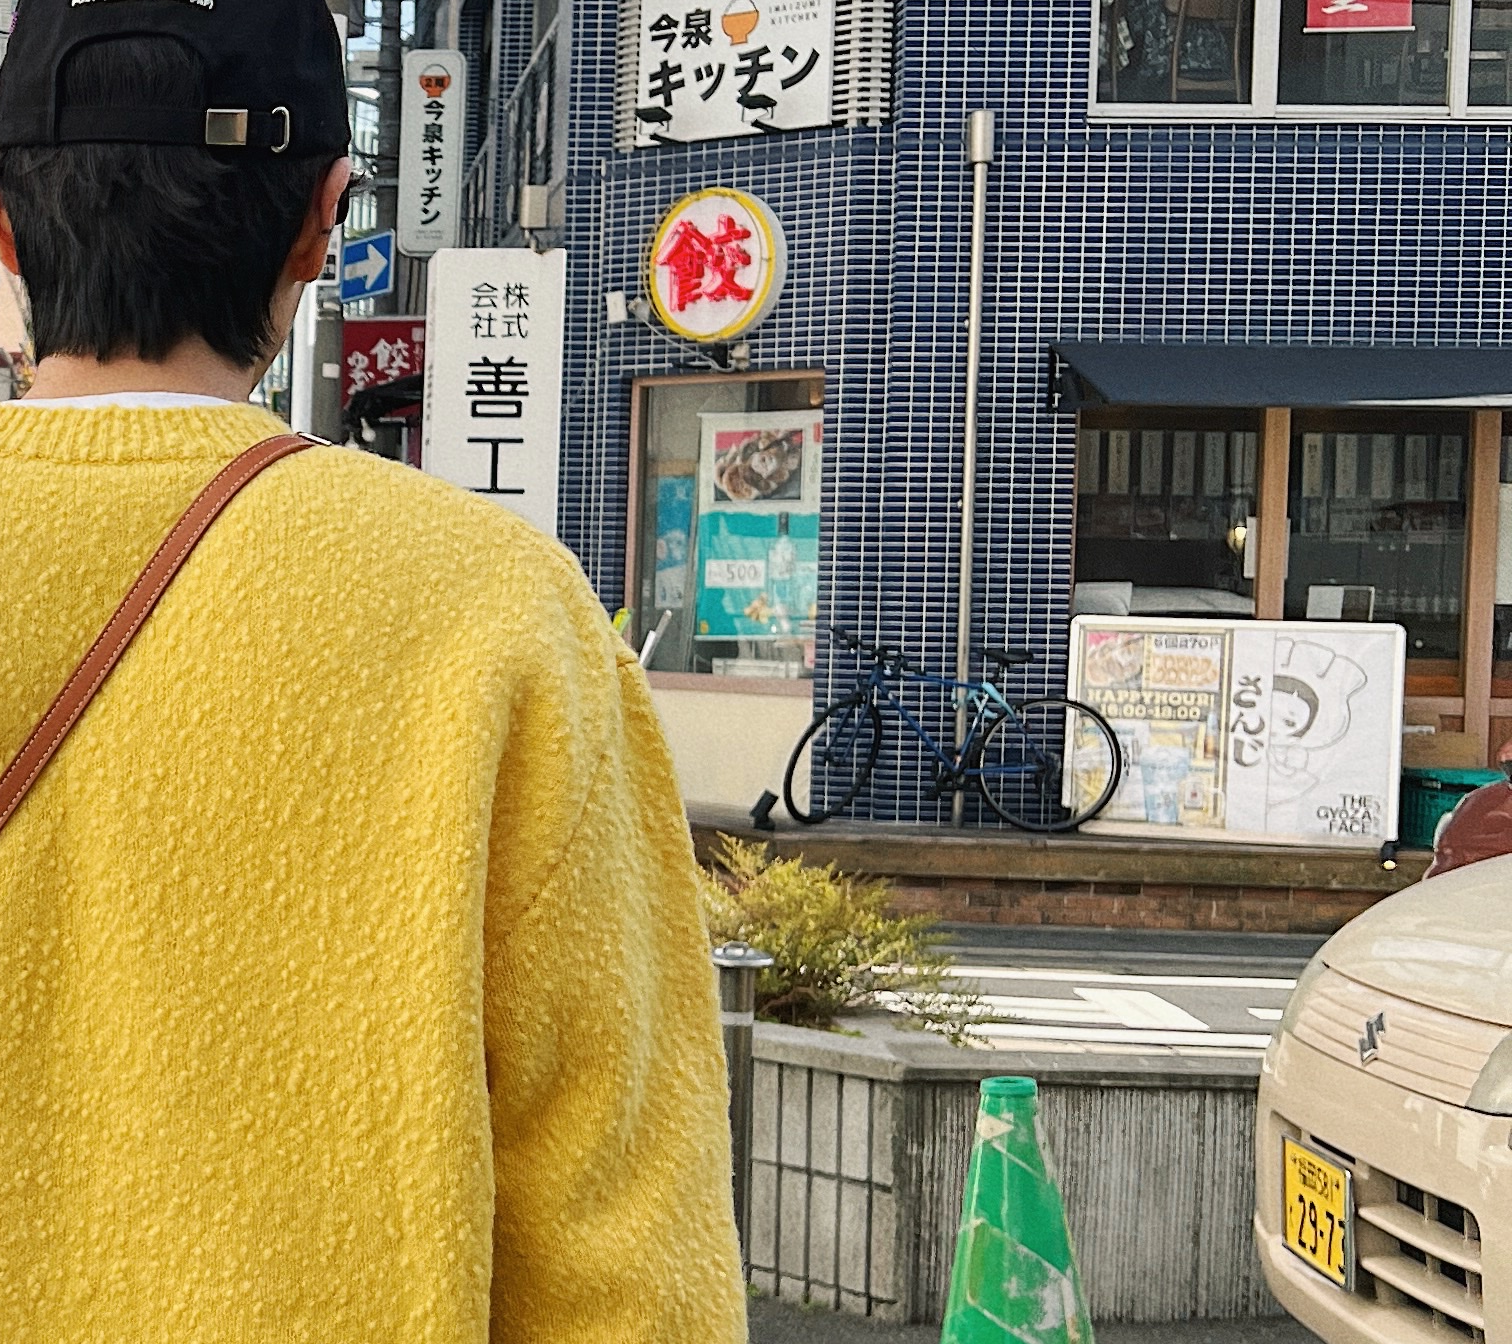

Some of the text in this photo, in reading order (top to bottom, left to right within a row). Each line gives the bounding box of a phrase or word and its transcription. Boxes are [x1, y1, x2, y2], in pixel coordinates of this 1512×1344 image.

[649, 8, 713, 52] 今泉
[649, 45, 820, 107] キッチン
[420, 100, 446, 226] 今泉キッチン
[656, 212, 753, 314] 餃
[465, 356, 530, 496] 善工
[1316, 806, 1372, 822] GYOZA
[1329, 820, 1371, 834] FACE
[1340, 794, 1373, 808] THE
